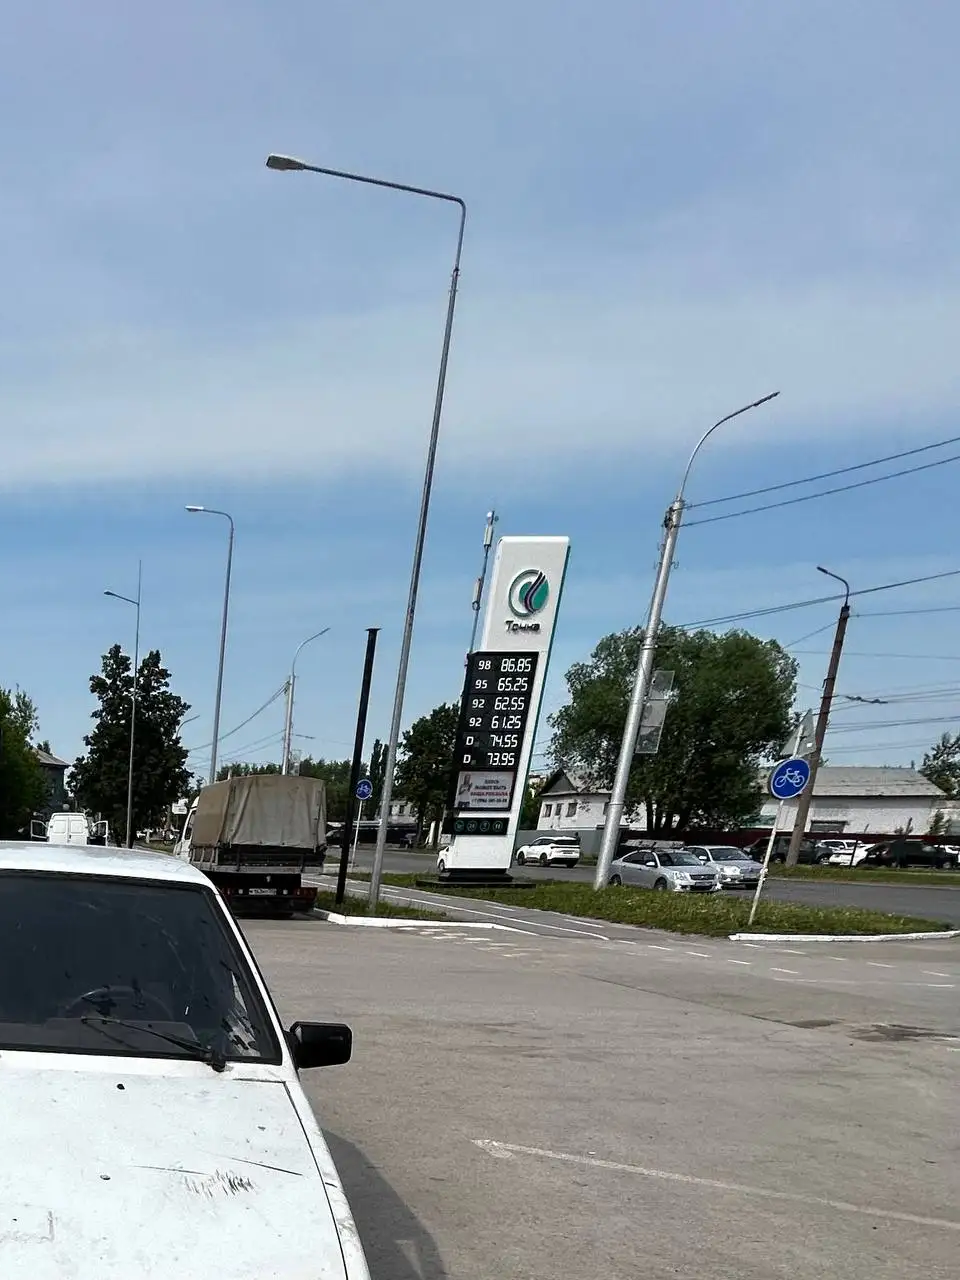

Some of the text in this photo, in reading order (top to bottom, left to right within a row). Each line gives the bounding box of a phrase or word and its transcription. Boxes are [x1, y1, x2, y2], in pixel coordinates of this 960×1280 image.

[478, 658, 531, 672] 98 86.85
[475, 678, 528, 691] 95 65.25
[472, 697, 525, 710] 92 62.55
[469, 716, 521, 729] 92 61.25
[465, 734, 518, 748] D 74.55
[463, 753, 515, 766] D 73.95
